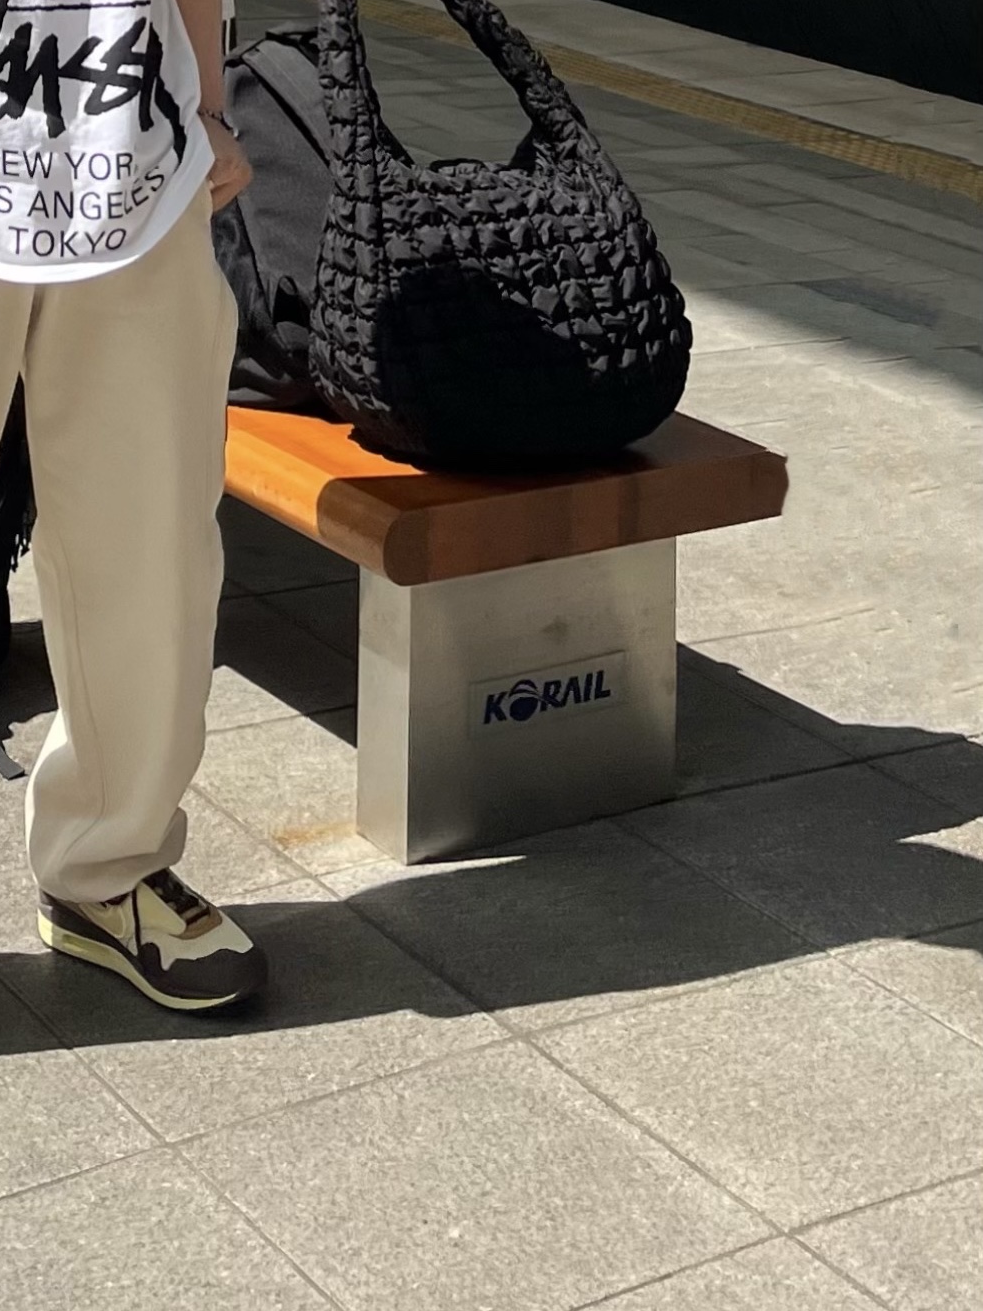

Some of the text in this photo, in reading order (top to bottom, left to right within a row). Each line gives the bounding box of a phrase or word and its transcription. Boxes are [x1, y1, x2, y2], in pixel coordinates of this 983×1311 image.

[64, 152, 138, 181] YOR
[27, 165, 165, 220] ANGELES
[8, 226, 127, 258] TOKYO
[483, 669, 612, 725] KORAIL
